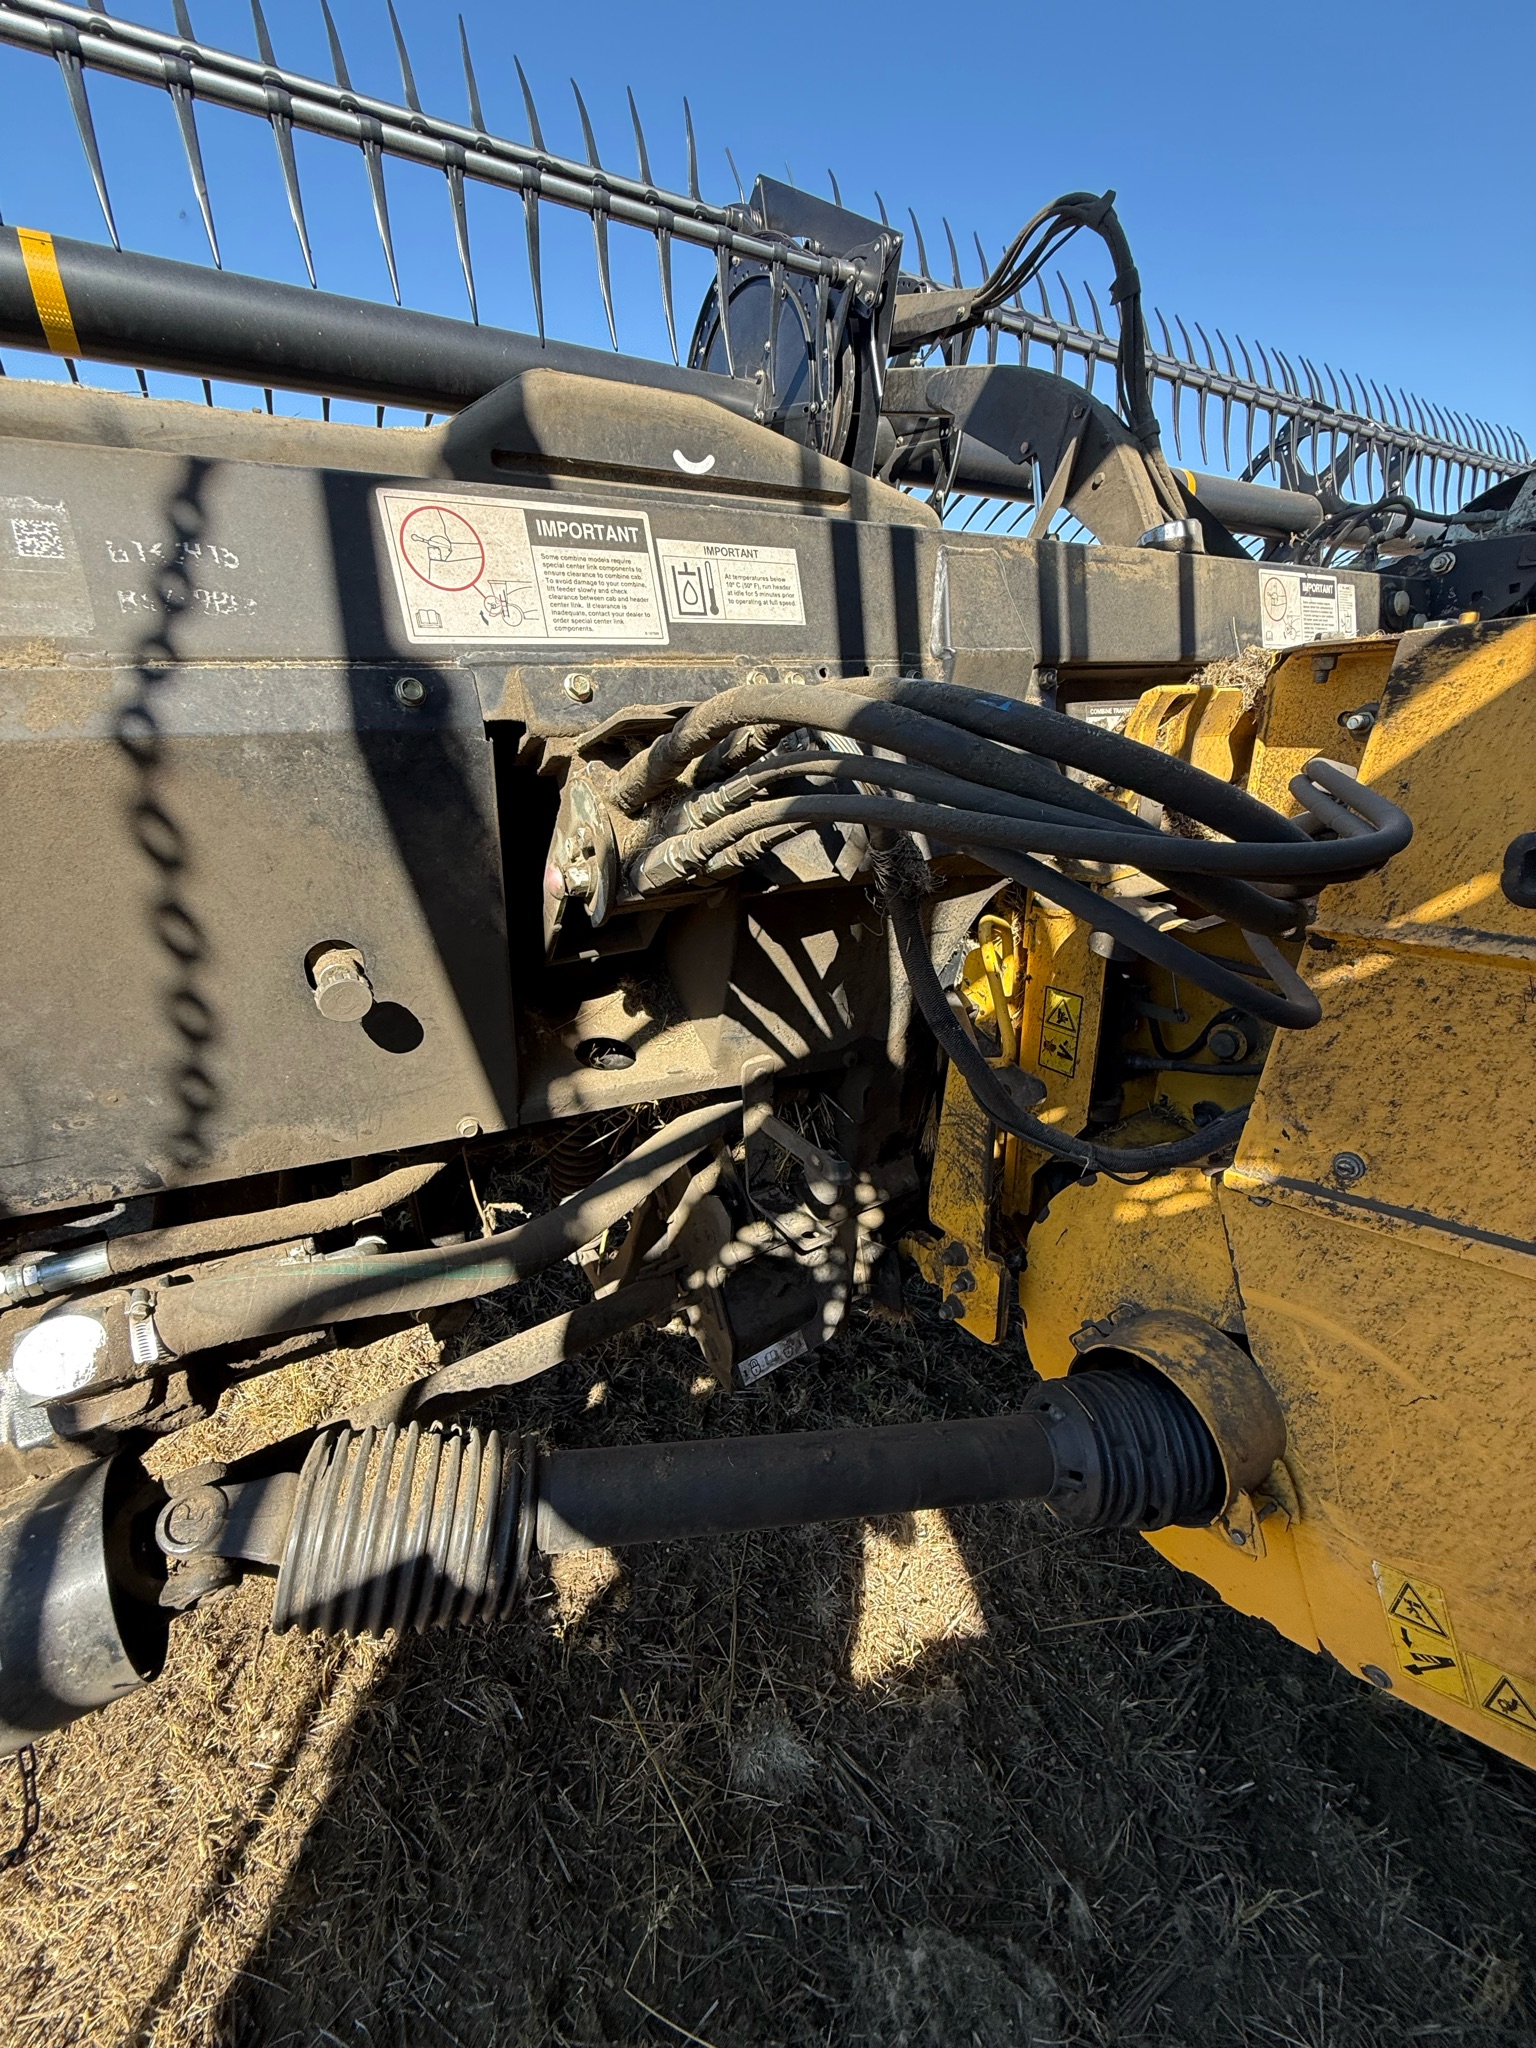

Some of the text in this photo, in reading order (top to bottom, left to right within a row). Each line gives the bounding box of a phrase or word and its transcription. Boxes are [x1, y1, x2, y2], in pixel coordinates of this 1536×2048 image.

[536, 519, 638, 542] IMPORTANT
[704, 546, 758, 558] IMPORTANT
[543, 561, 564, 569] special
[733, 574, 769, 582] temperatures
[1302, 582, 1334, 594] IMPORTANT
